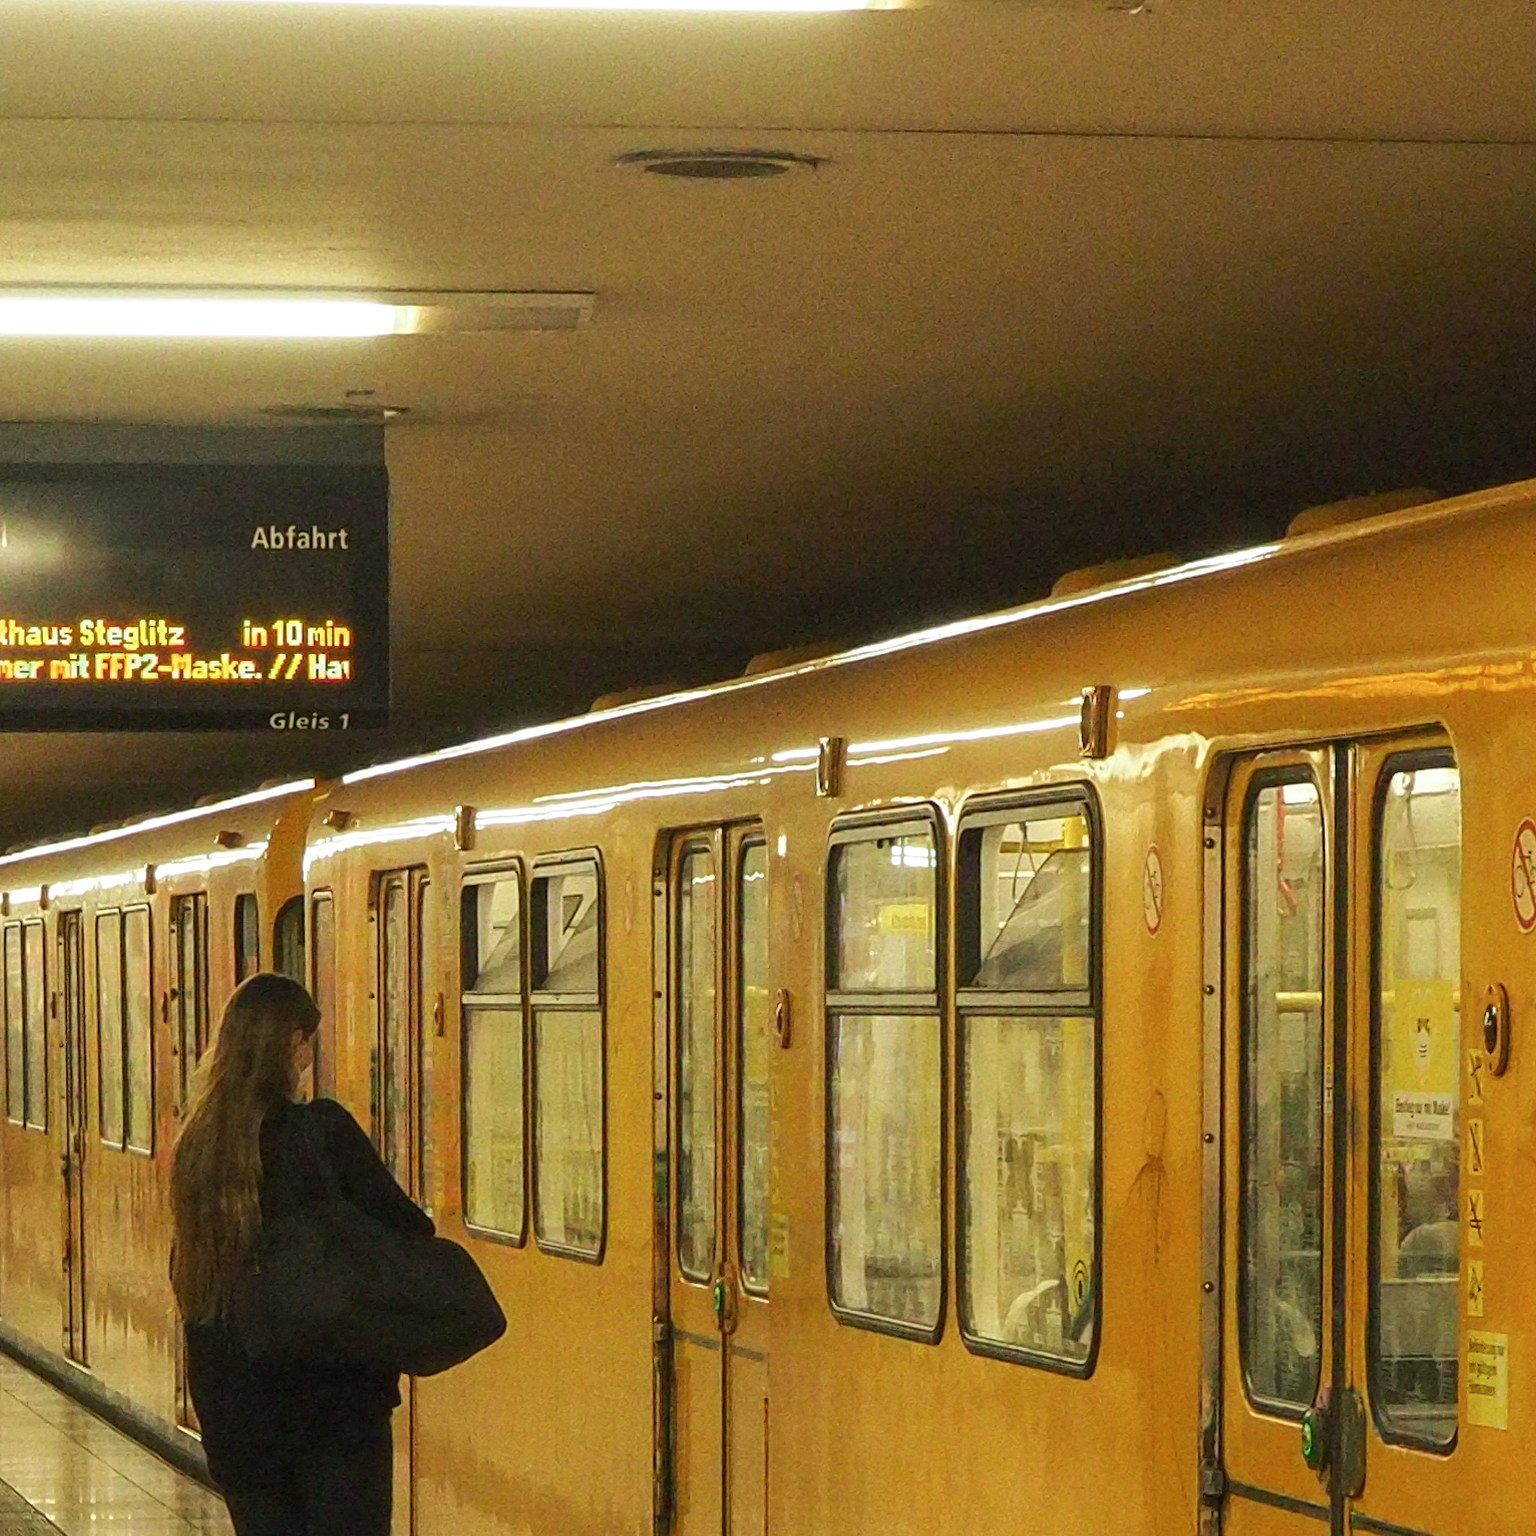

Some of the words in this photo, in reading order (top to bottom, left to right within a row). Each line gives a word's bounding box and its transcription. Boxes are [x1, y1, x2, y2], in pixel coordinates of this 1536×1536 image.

[250, 525, 349, 550] Abfahrt
[78, 618, 185, 652] Steglitz
[242, 618, 268, 647] in
[272, 618, 305, 647] 10
[307, 618, 351, 647] min
[50, 652, 91, 680] mit
[94, 652, 263, 681] FFP2-Maske.
[268, 711, 330, 731] Gleis
[339, 712, 351, 731] 1
